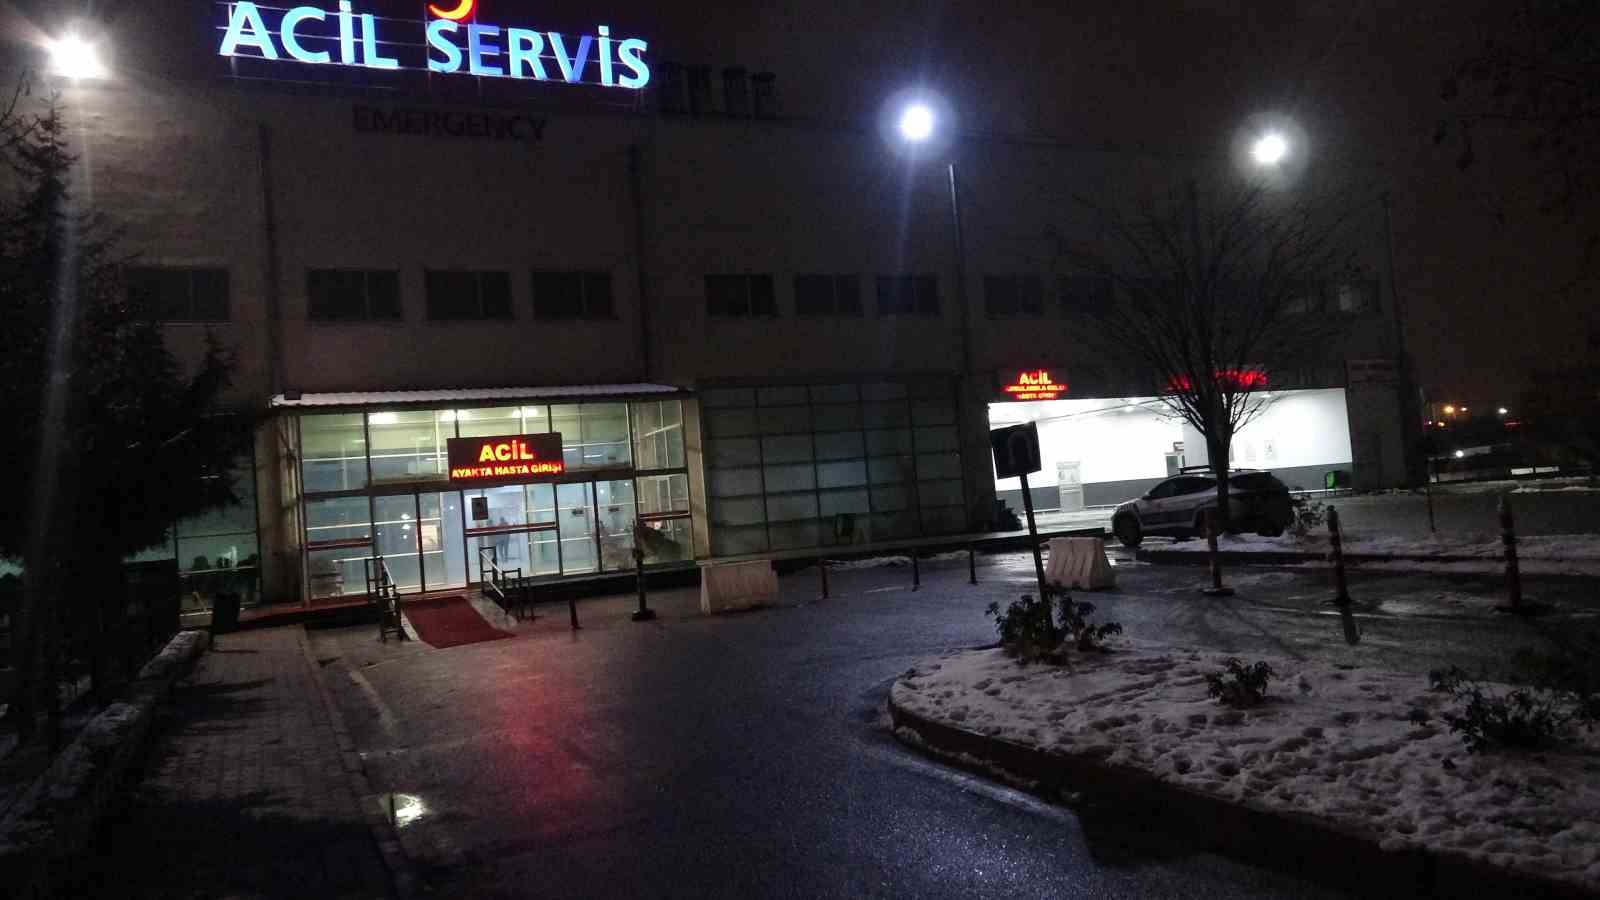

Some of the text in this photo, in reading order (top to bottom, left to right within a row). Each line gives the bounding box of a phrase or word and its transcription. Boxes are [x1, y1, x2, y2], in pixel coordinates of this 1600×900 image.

[218, 0, 650, 89] ACİL SERVİS
[354, 106, 546, 140] EMERGENCY
[1019, 369, 1053, 385] ACİL
[480, 440, 534, 462] ACİL
[452, 466, 493, 478] AYAKTA
[495, 465, 529, 476] HASTA
